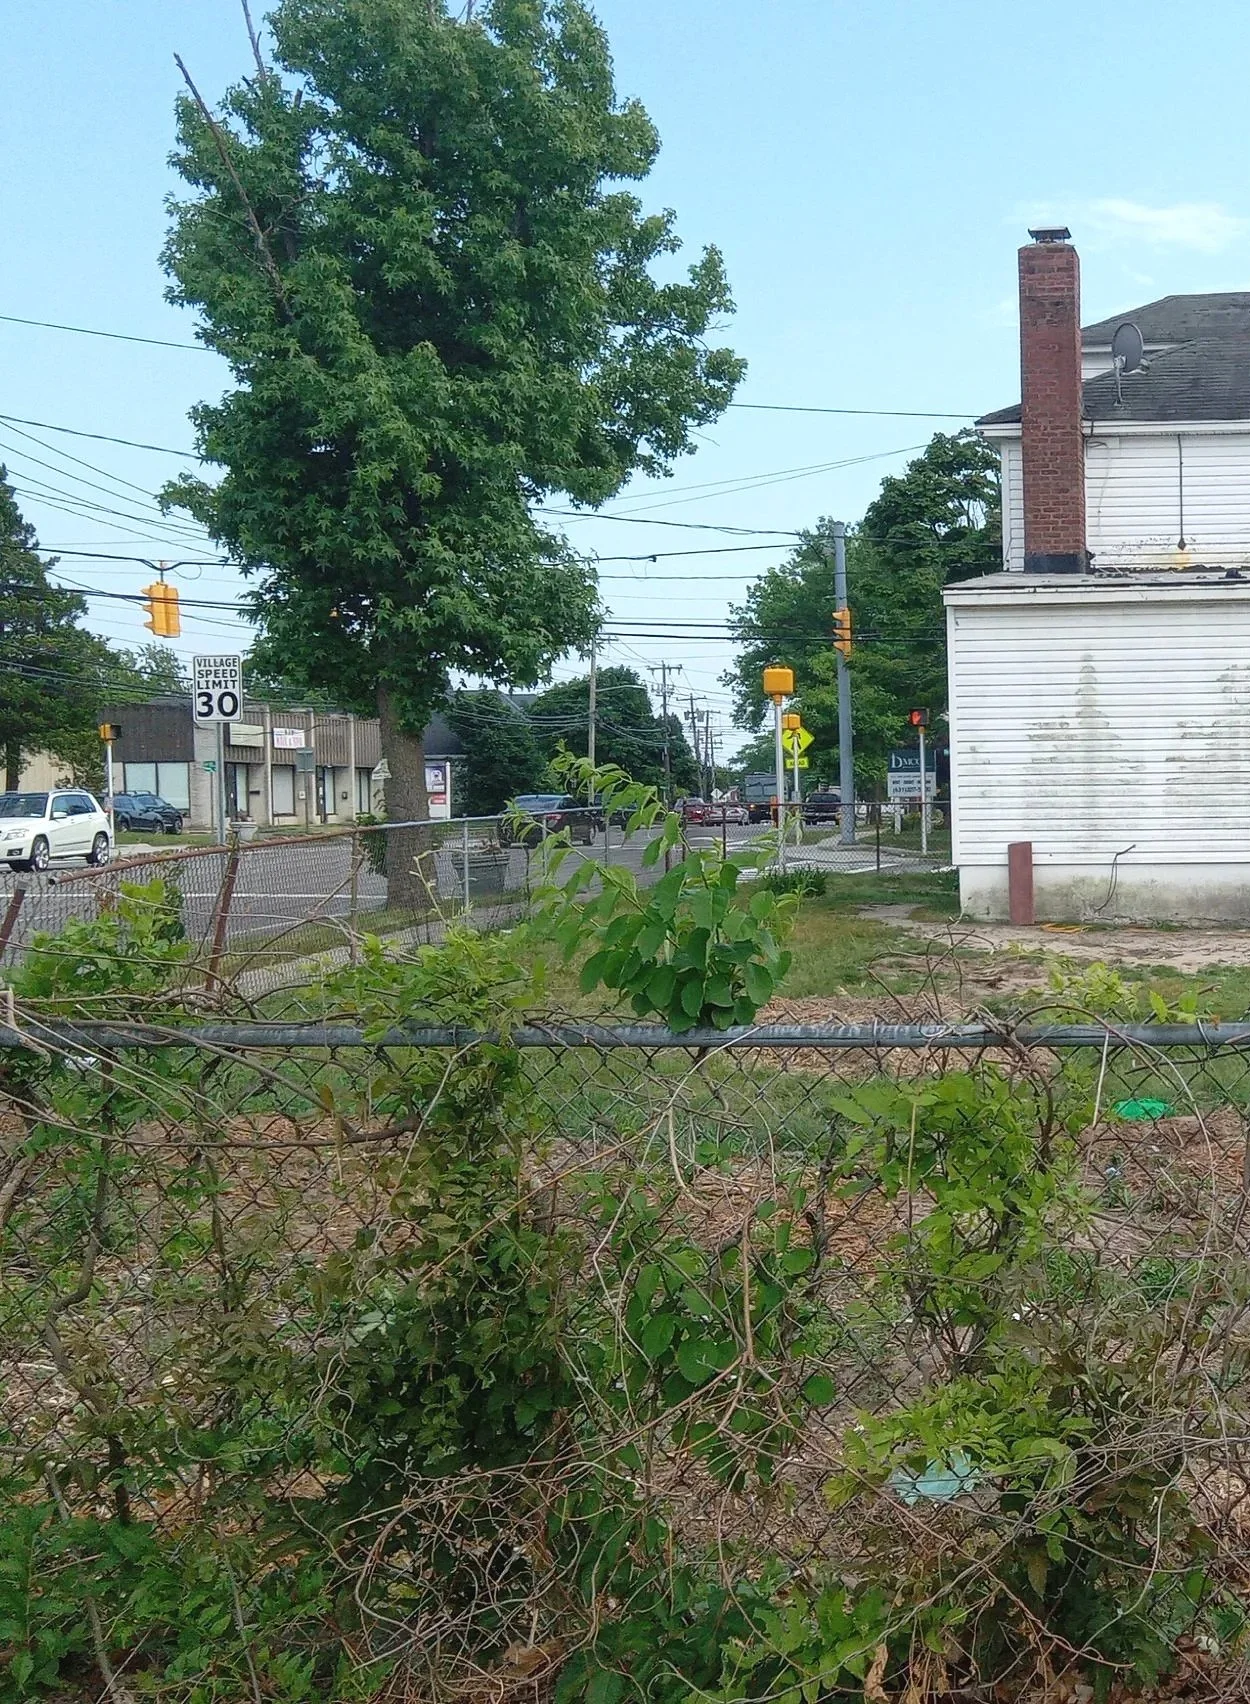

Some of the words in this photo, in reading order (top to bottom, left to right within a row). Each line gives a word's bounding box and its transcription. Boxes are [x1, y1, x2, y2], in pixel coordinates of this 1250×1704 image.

[196, 658, 237, 667] VILLAGE
[197, 669, 237, 678] SPEED
[197, 680, 237, 689] LIMIT
[197, 691, 238, 717] 30
